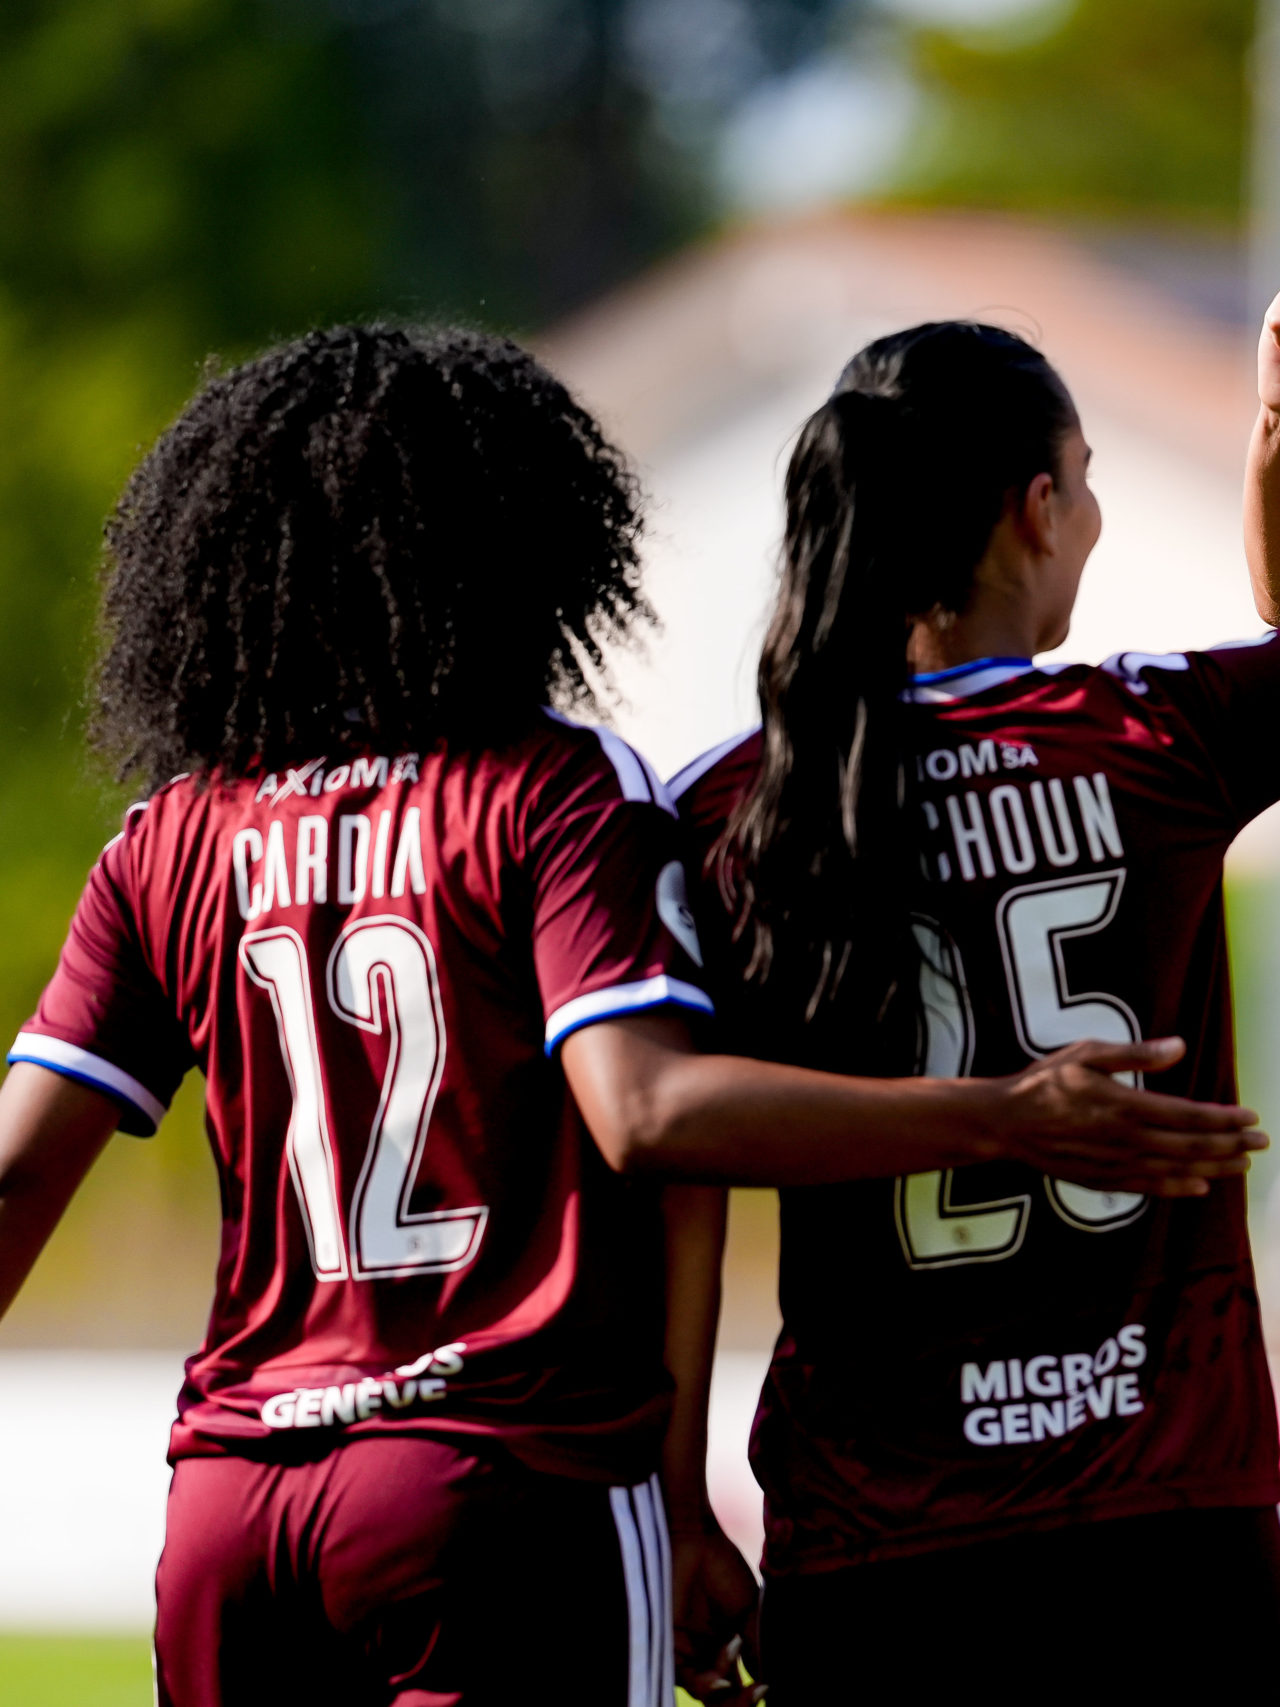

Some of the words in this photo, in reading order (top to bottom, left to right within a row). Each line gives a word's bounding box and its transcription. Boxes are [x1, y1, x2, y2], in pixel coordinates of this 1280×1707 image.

[255, 756, 389, 809] AXIOM
[916, 739, 998, 781] OM
[1001, 742, 1039, 769] SA
[233, 806, 427, 921] CARDIA
[239, 913, 490, 1282] 12
[960, 1323, 1148, 1404] MIGROS
